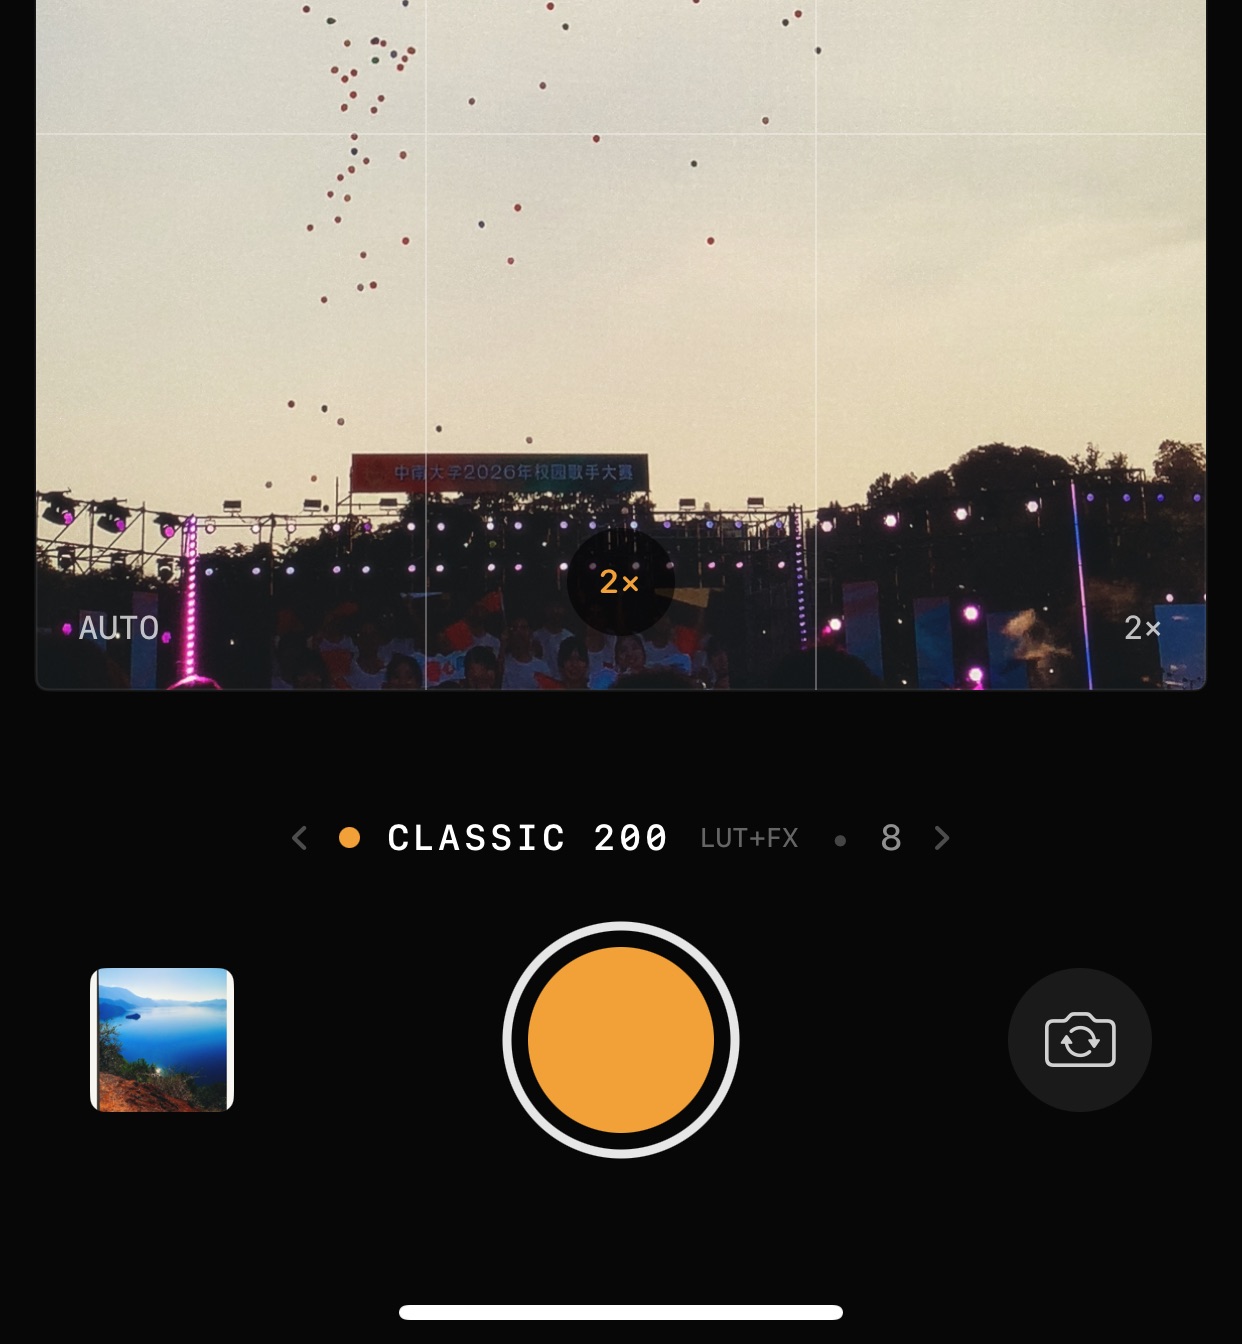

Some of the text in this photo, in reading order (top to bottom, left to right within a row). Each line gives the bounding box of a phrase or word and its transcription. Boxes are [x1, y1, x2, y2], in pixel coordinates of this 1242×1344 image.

[394, 464, 634, 481] 中南大学2026年校园歌手大赛
